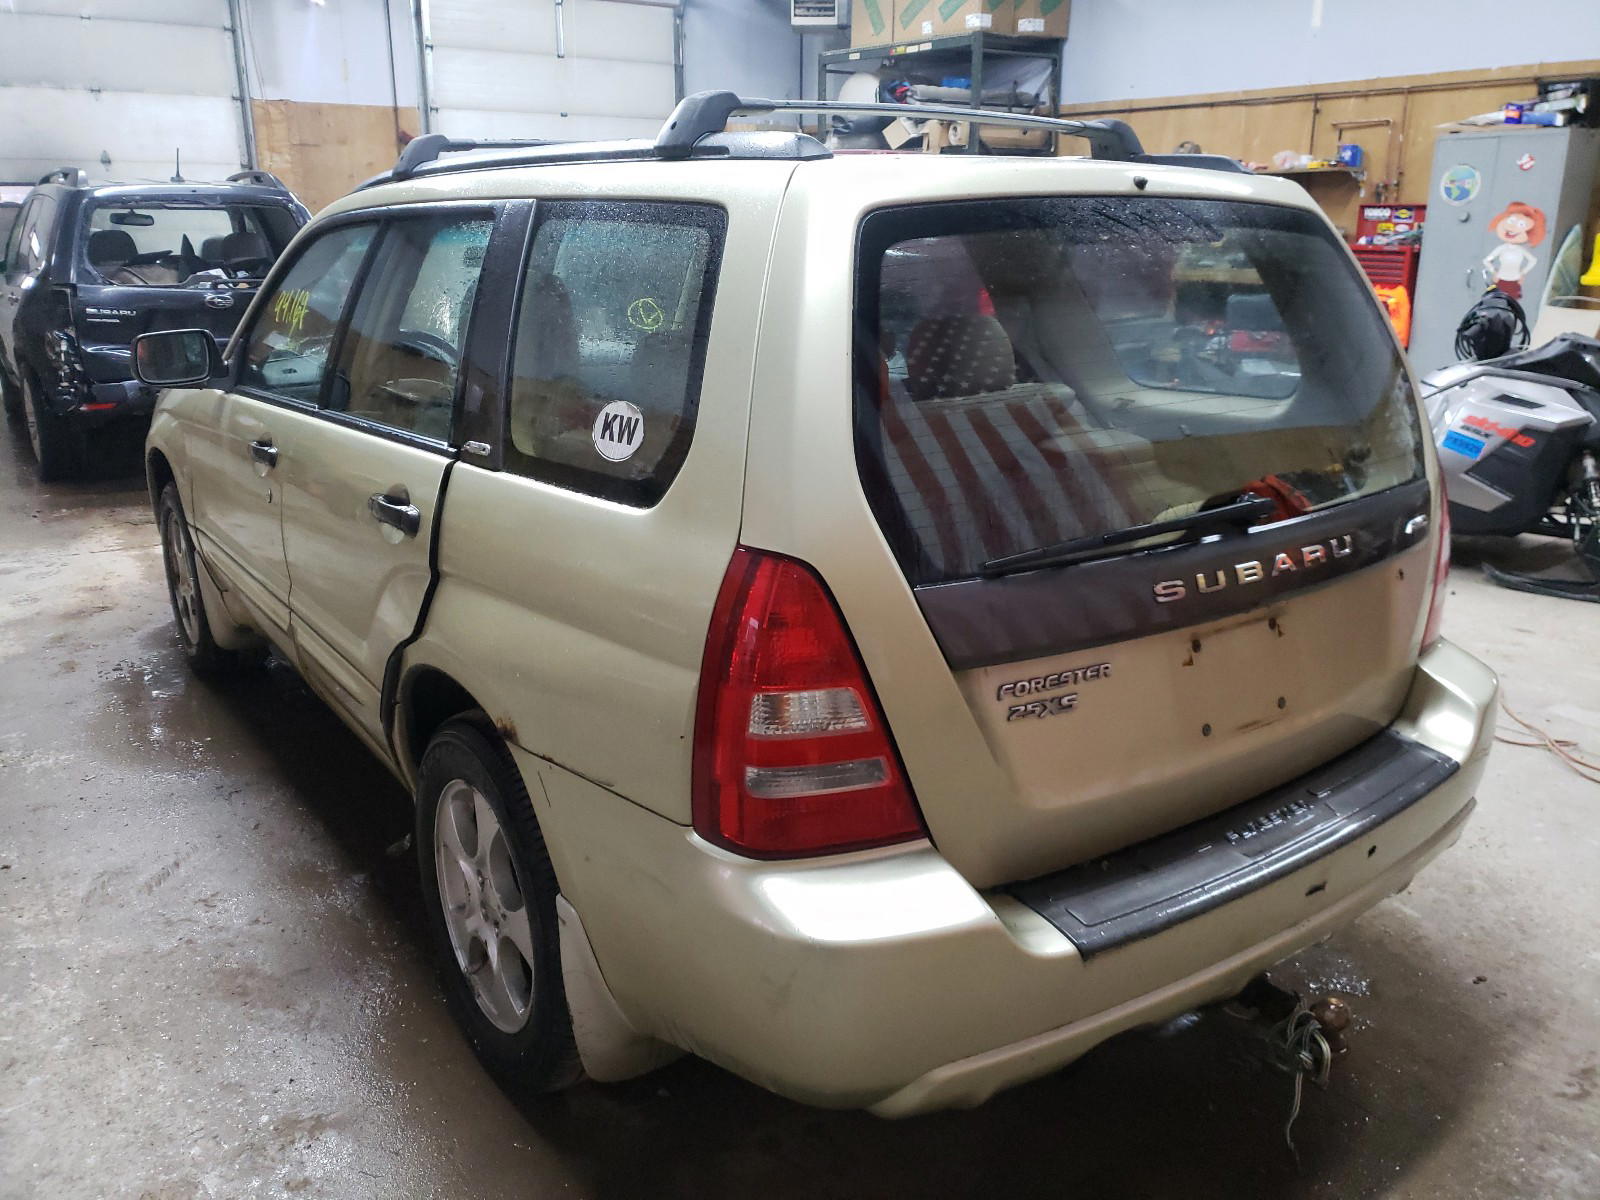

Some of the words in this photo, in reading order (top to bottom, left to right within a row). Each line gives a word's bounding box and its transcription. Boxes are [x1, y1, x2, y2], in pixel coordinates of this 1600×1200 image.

[600, 412, 640, 446] KW
[1153, 534, 1353, 604] SUBARU
[997, 662, 1112, 702] FORESTER
